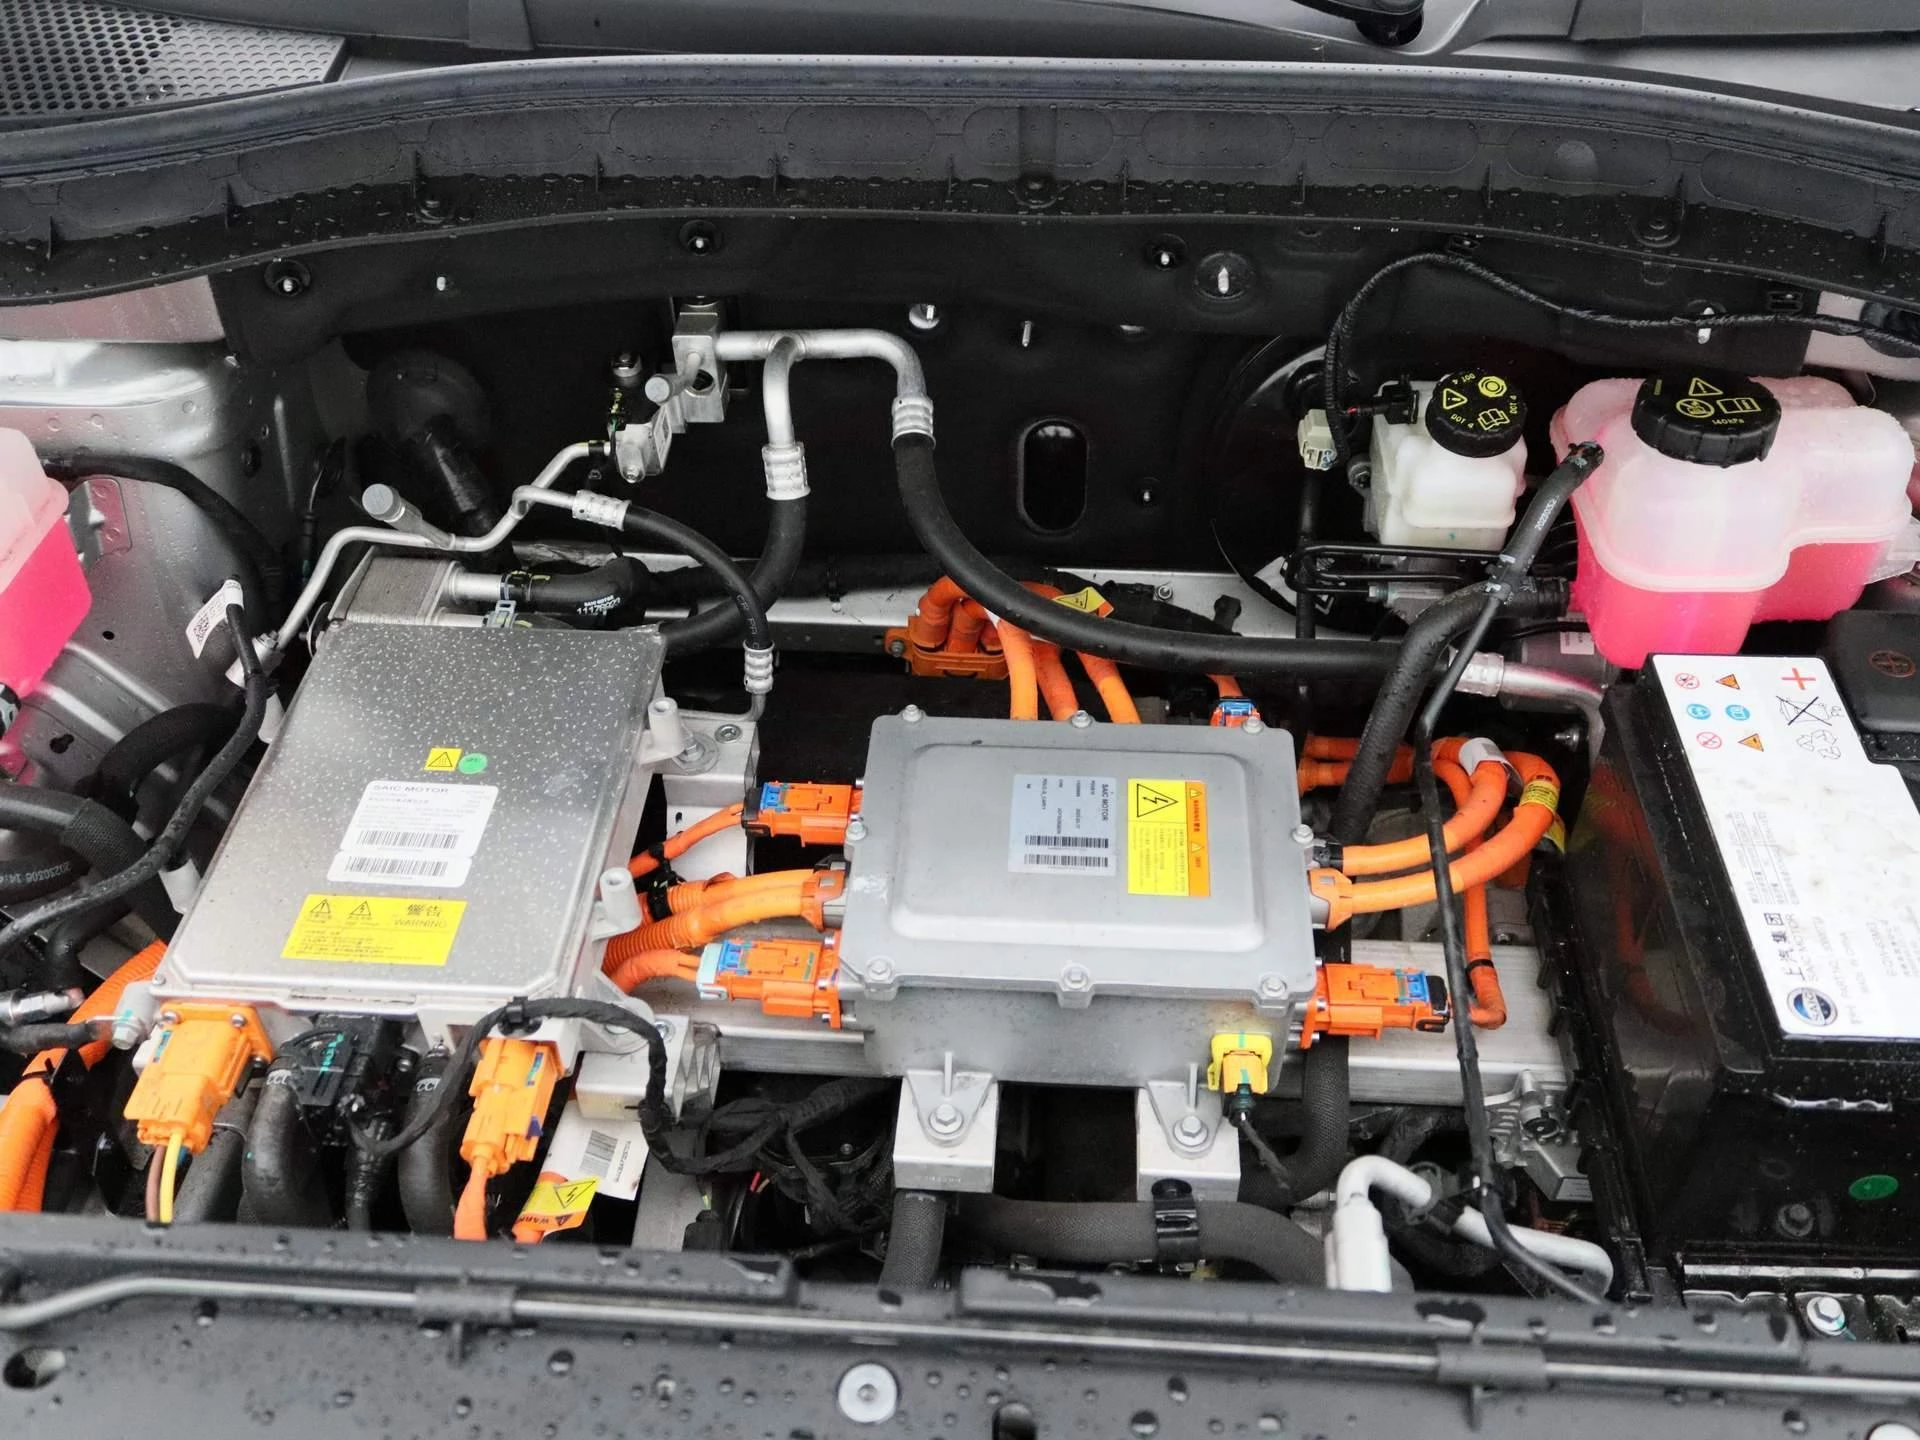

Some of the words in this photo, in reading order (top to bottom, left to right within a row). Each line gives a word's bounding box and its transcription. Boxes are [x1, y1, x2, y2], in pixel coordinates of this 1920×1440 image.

[1461, 373, 1476, 383] DOT
[1509, 402, 1518, 414] DOT
[1450, 413, 1466, 424] DOT
[405, 785, 449, 794] MOTOR
